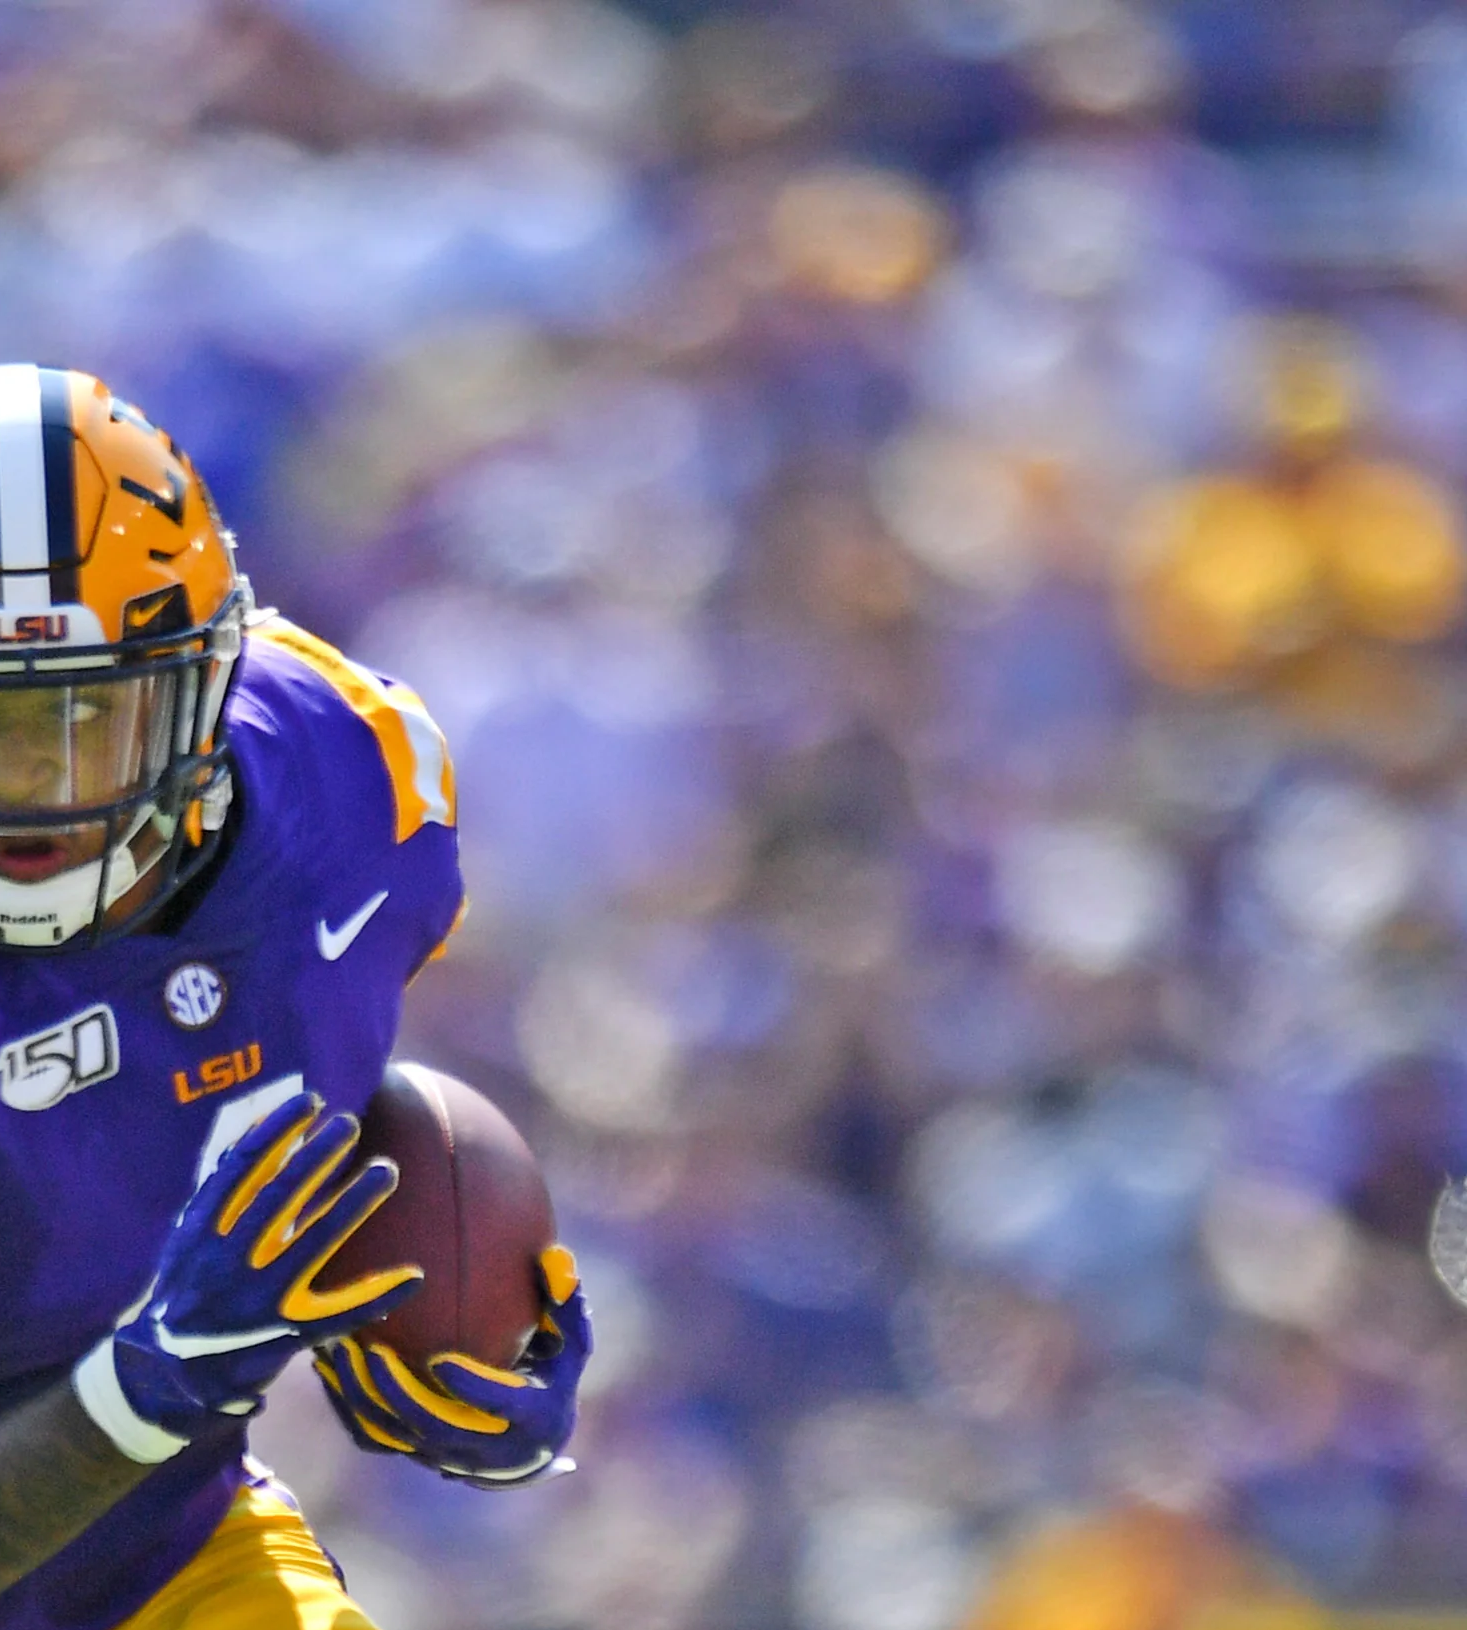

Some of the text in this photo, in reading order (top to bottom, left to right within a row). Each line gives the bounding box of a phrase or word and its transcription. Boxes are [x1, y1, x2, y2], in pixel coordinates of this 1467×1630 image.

[168, 964, 224, 1026] SEC
[1, 1007, 117, 1107] 150
[173, 1042, 262, 1105] LSU
